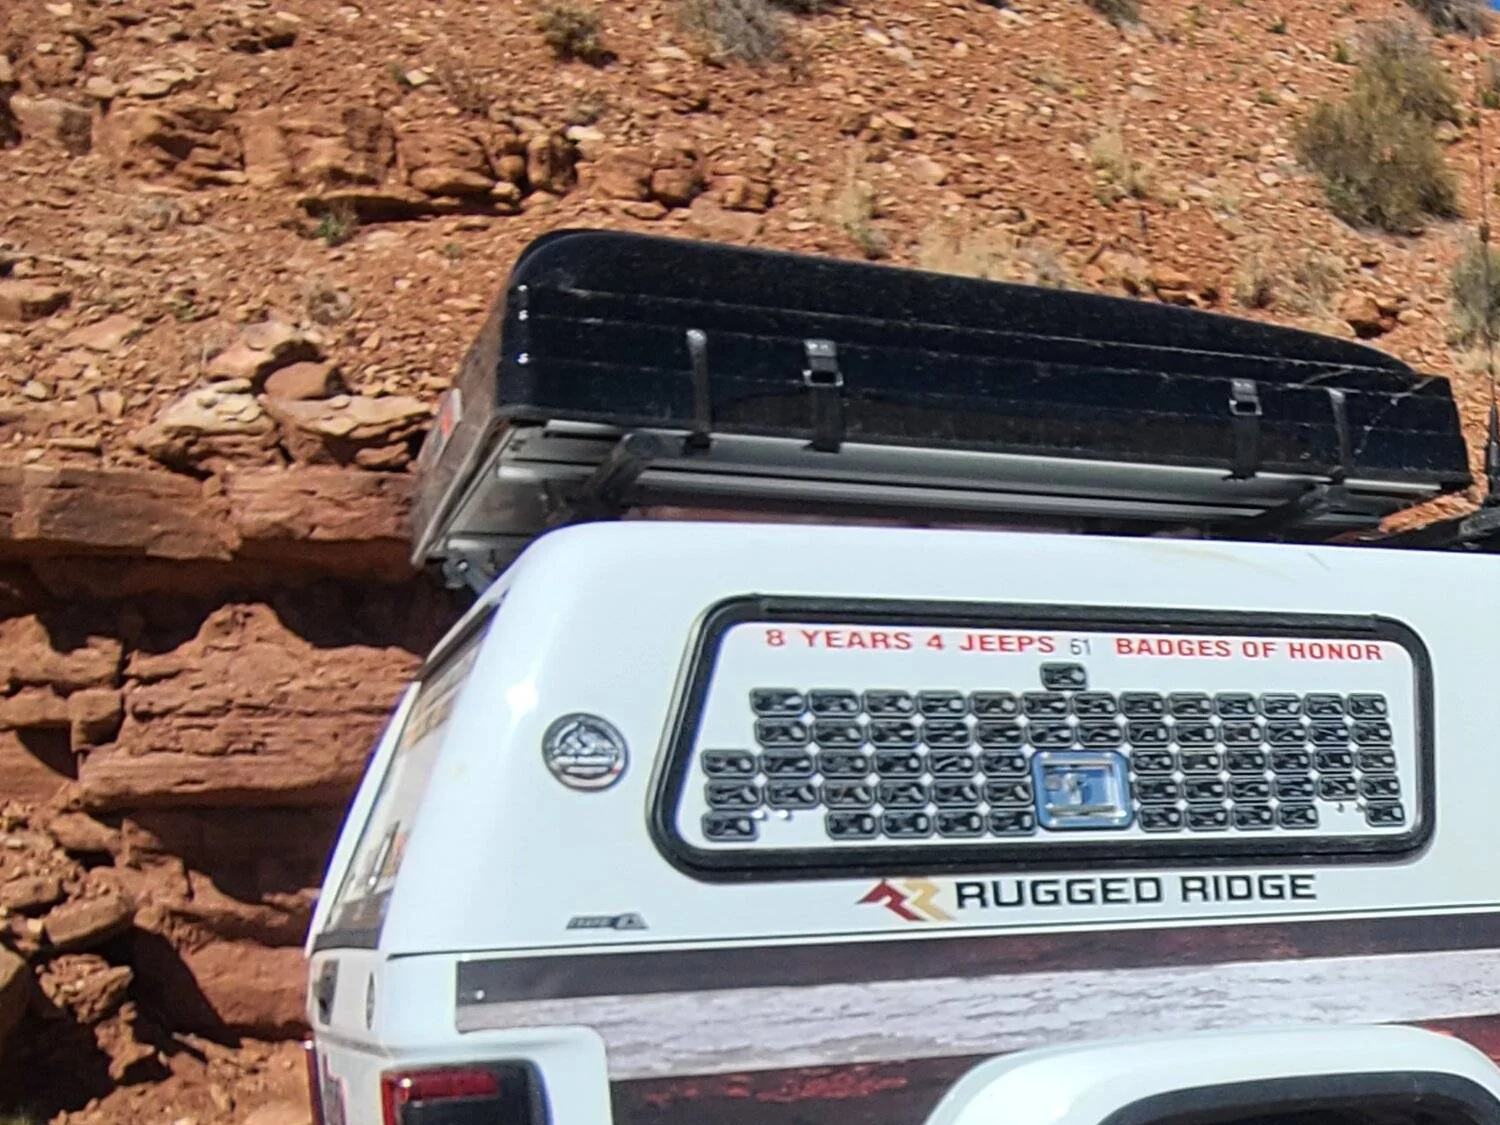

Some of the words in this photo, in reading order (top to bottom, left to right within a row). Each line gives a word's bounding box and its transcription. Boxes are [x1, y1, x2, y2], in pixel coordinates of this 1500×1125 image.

[766, 629, 785, 648] 8
[800, 629, 913, 651] YEARS
[926, 633, 945, 651] 4
[959, 634, 1056, 654] JEEPS
[1116, 637, 1231, 658] BADGES
[1242, 640, 1277, 659] OF
[1288, 641, 1383, 661] HONOR
[955, 876, 1163, 910] RUGGED
[1179, 873, 1318, 903] RIDGE
